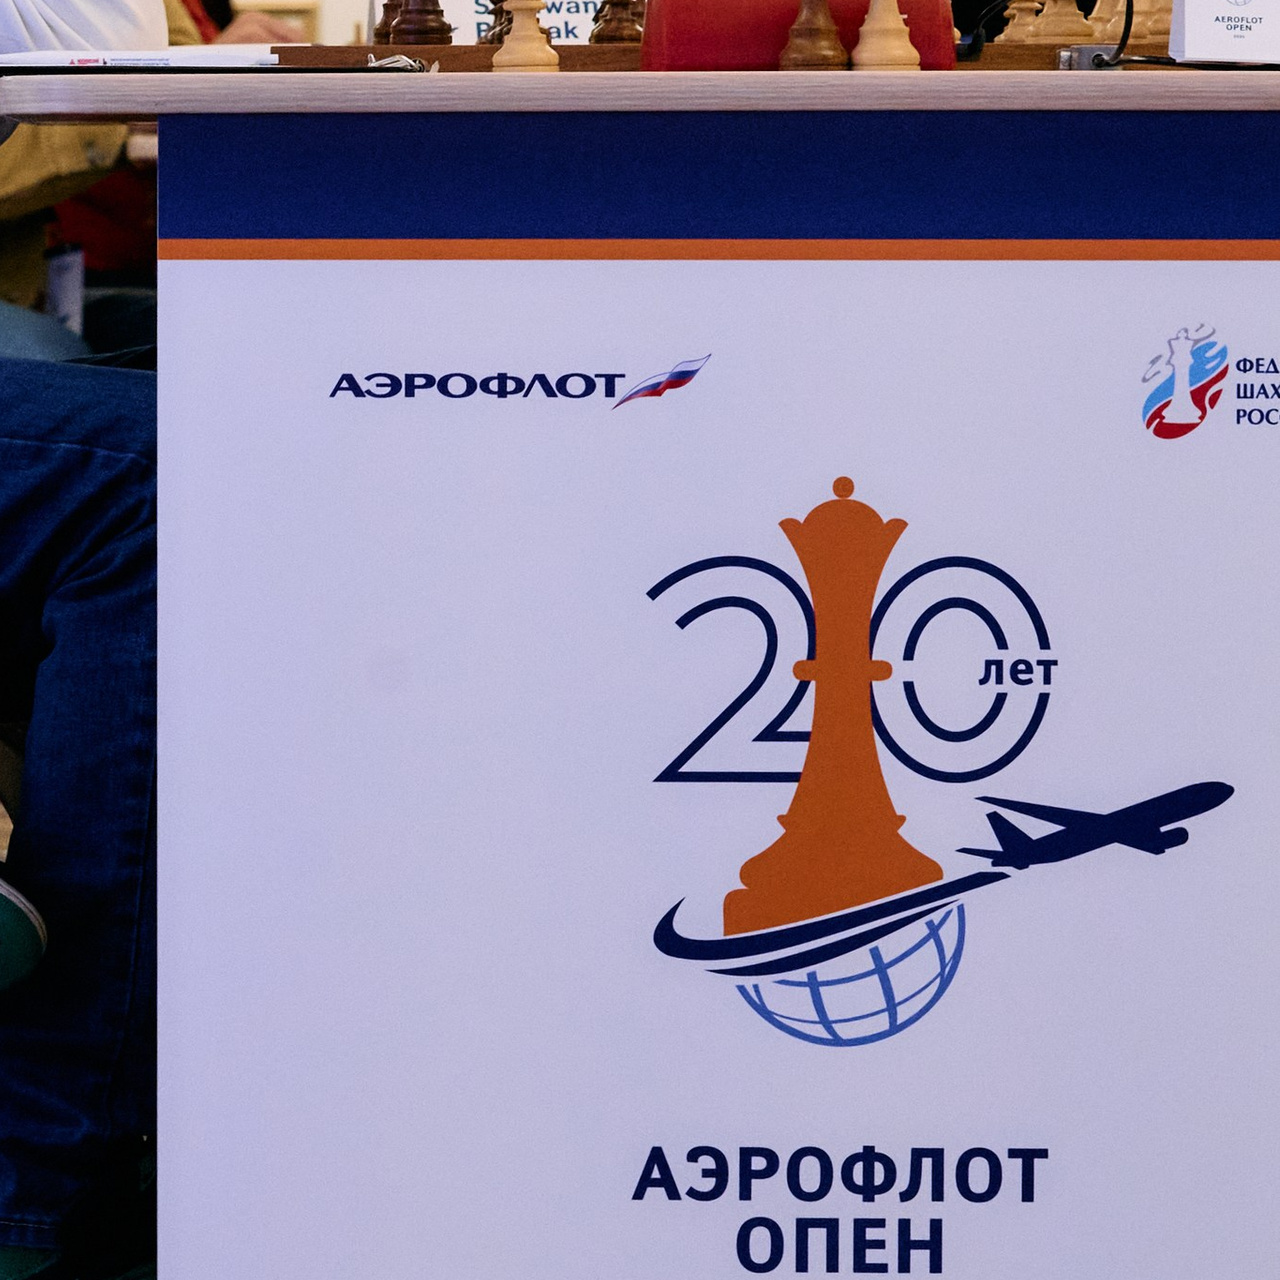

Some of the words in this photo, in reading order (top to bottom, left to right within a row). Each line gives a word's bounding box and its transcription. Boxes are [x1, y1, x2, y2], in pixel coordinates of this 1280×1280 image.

[1214, 15, 1263, 24] AEROFLOT
[329, 372, 626, 399] АЭРОФЛОТ
[1236, 408, 1280, 426] РОС
[645, 555, 1051, 784] 20
[978, 658, 1059, 686] лет
[631, 1145, 1049, 1204] АЭРОФЛОТ
[735, 1216, 943, 1275] ОПЕН
